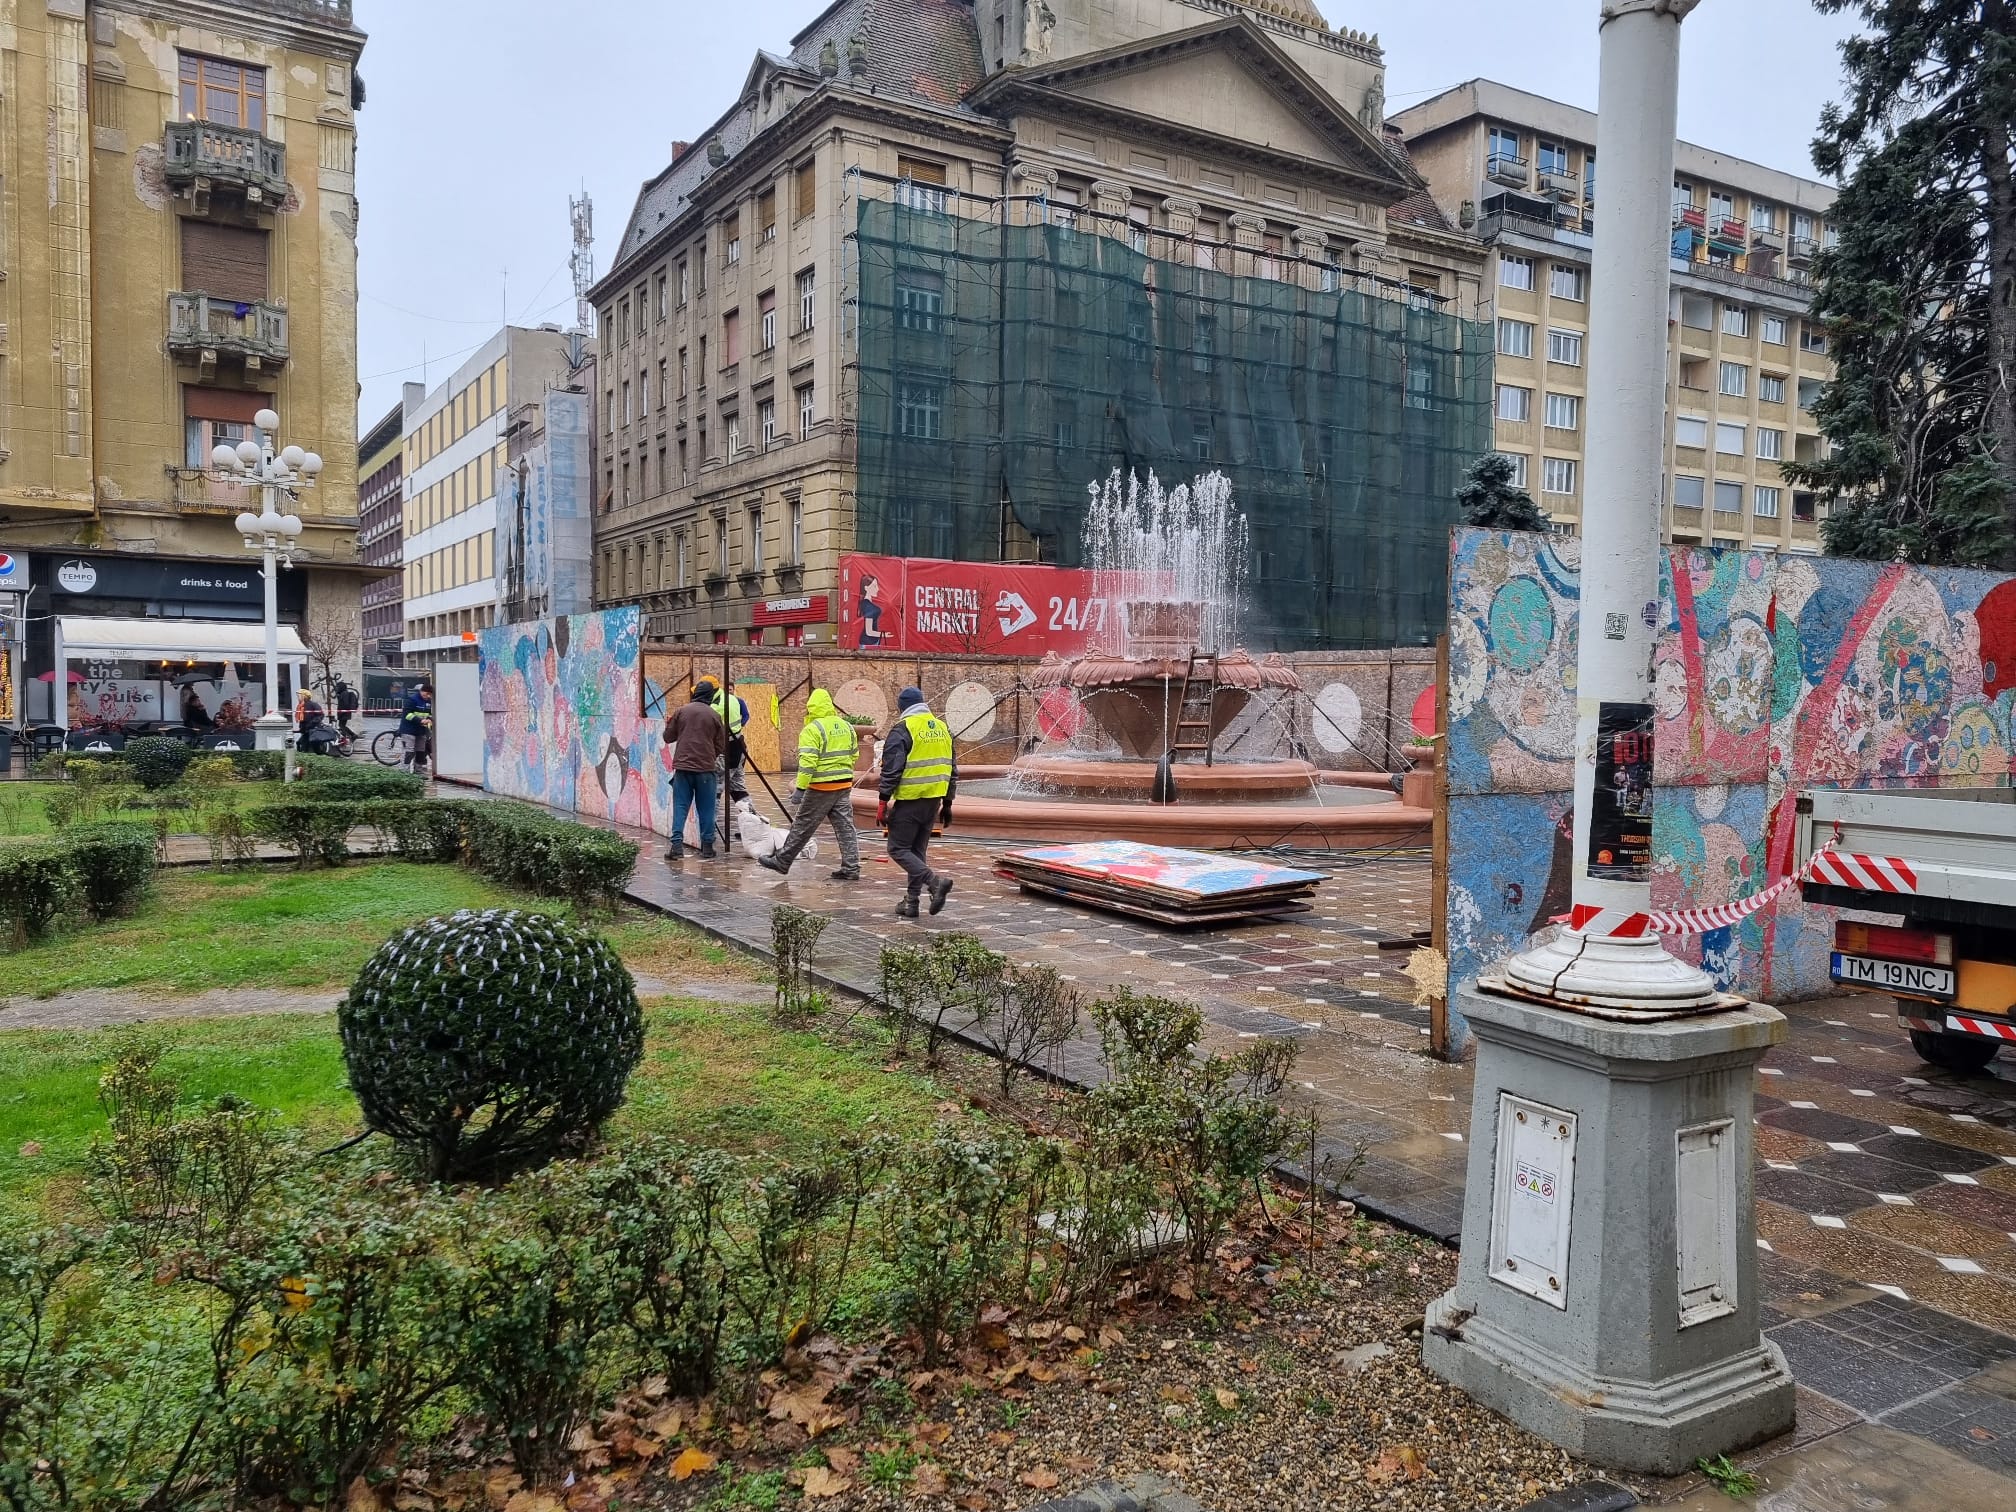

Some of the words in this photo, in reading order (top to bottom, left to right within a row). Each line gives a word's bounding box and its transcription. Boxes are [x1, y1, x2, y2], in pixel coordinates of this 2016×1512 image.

[181, 579, 212, 588] drinks
[215, 580, 223, 588] &
[226, 580, 248, 589] food
[915, 585, 981, 611] CENTRAL
[916, 610, 979, 635] MARKET
[1048, 596, 1108, 631] 24/7
[89, 665, 123, 679] the
[1832, 966, 1841, 975] RO
[1847, 958, 1875, 981] TM
[1884, 963, 1902, 984] 19
[1906, 967, 1949, 992] NCJ
